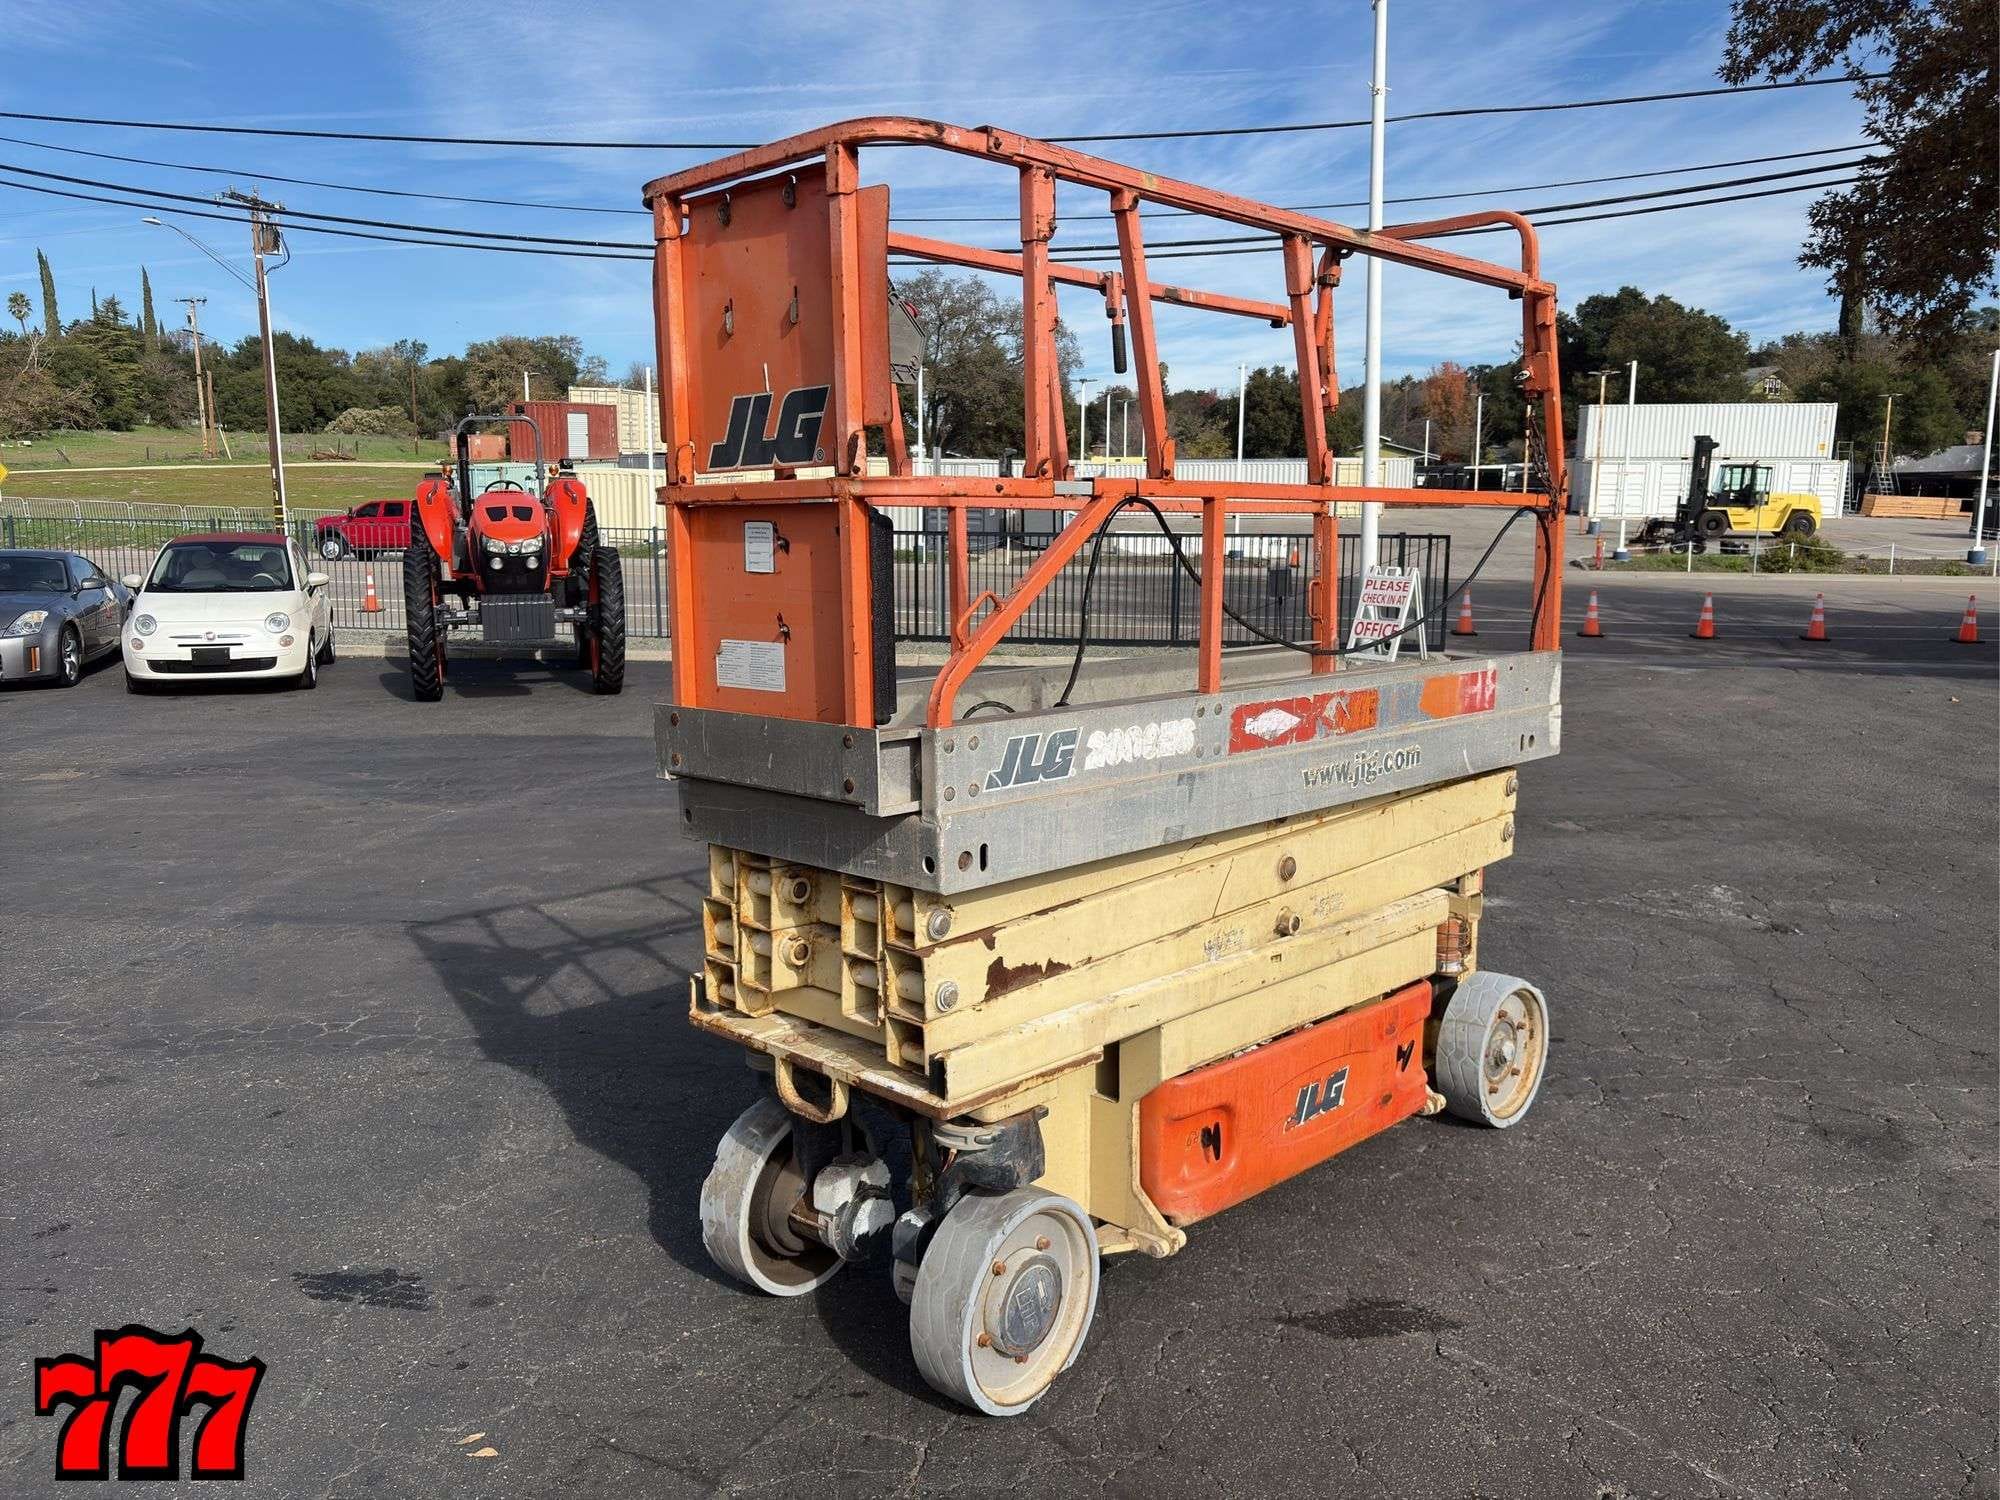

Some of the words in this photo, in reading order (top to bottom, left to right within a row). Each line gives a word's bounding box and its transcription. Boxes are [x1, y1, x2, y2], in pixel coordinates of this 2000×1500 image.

[708, 385, 831, 471] JLG
[1362, 592, 1387, 604] CHECK
[1387, 594, 1396, 605] IN
[1396, 595, 1407, 605] AT
[1365, 579, 1410, 592] PLEASE
[1354, 621, 1399, 638] OFFICE
[982, 727, 1083, 793] JLG
[1301, 744, 1422, 789] www.jlg.com
[1282, 1065, 1350, 1135] JLG
